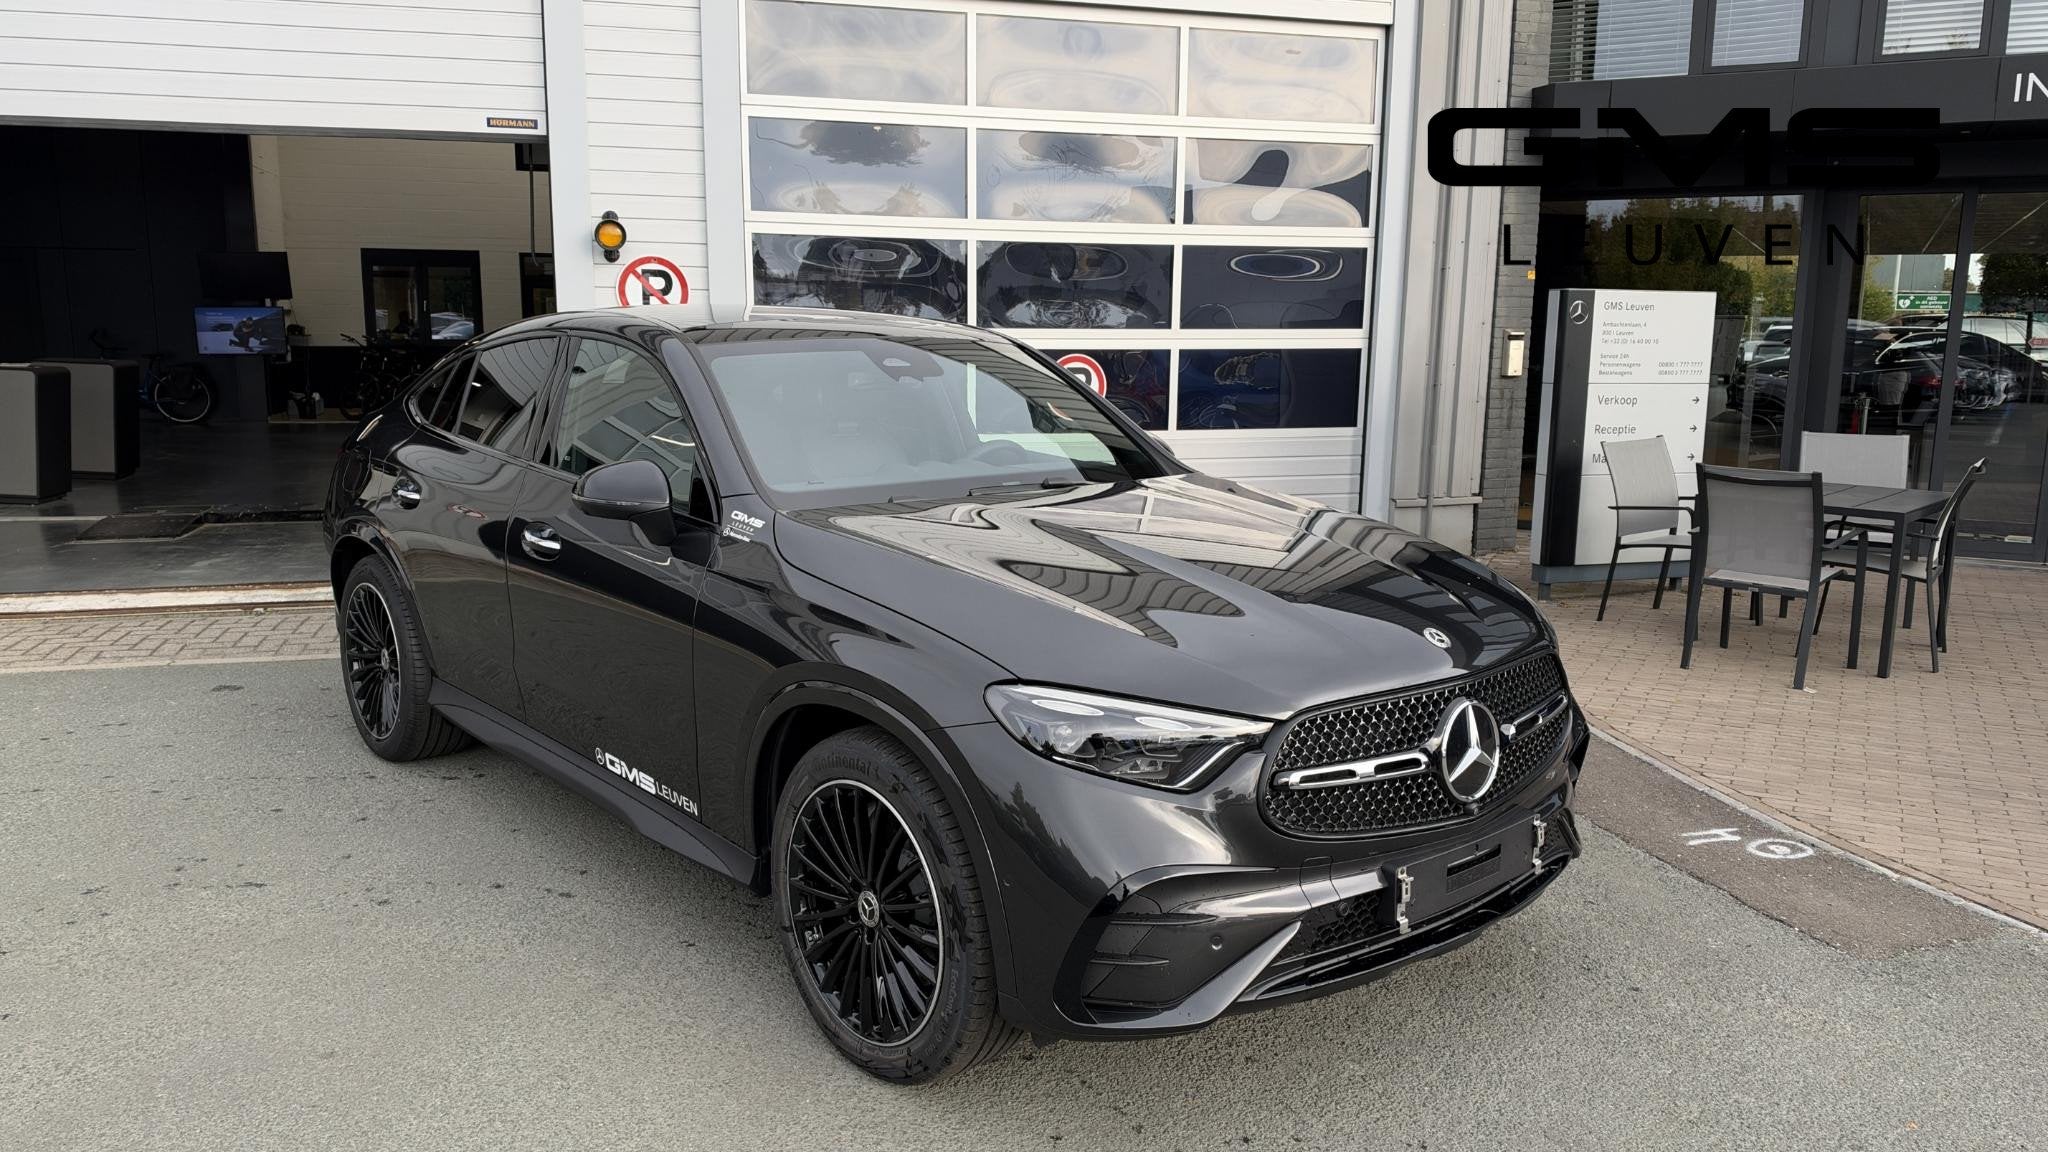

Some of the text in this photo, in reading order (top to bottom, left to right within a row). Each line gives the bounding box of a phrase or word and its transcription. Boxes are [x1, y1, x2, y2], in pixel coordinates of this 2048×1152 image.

[1603, 301, 1655, 311] GMS Leuven
[1597, 394, 1638, 407] Verkoop
[1594, 424, 1637, 436] Receptie
[731, 510, 766, 528] GMS
[604, 751, 699, 817] GMS LEUVEN
